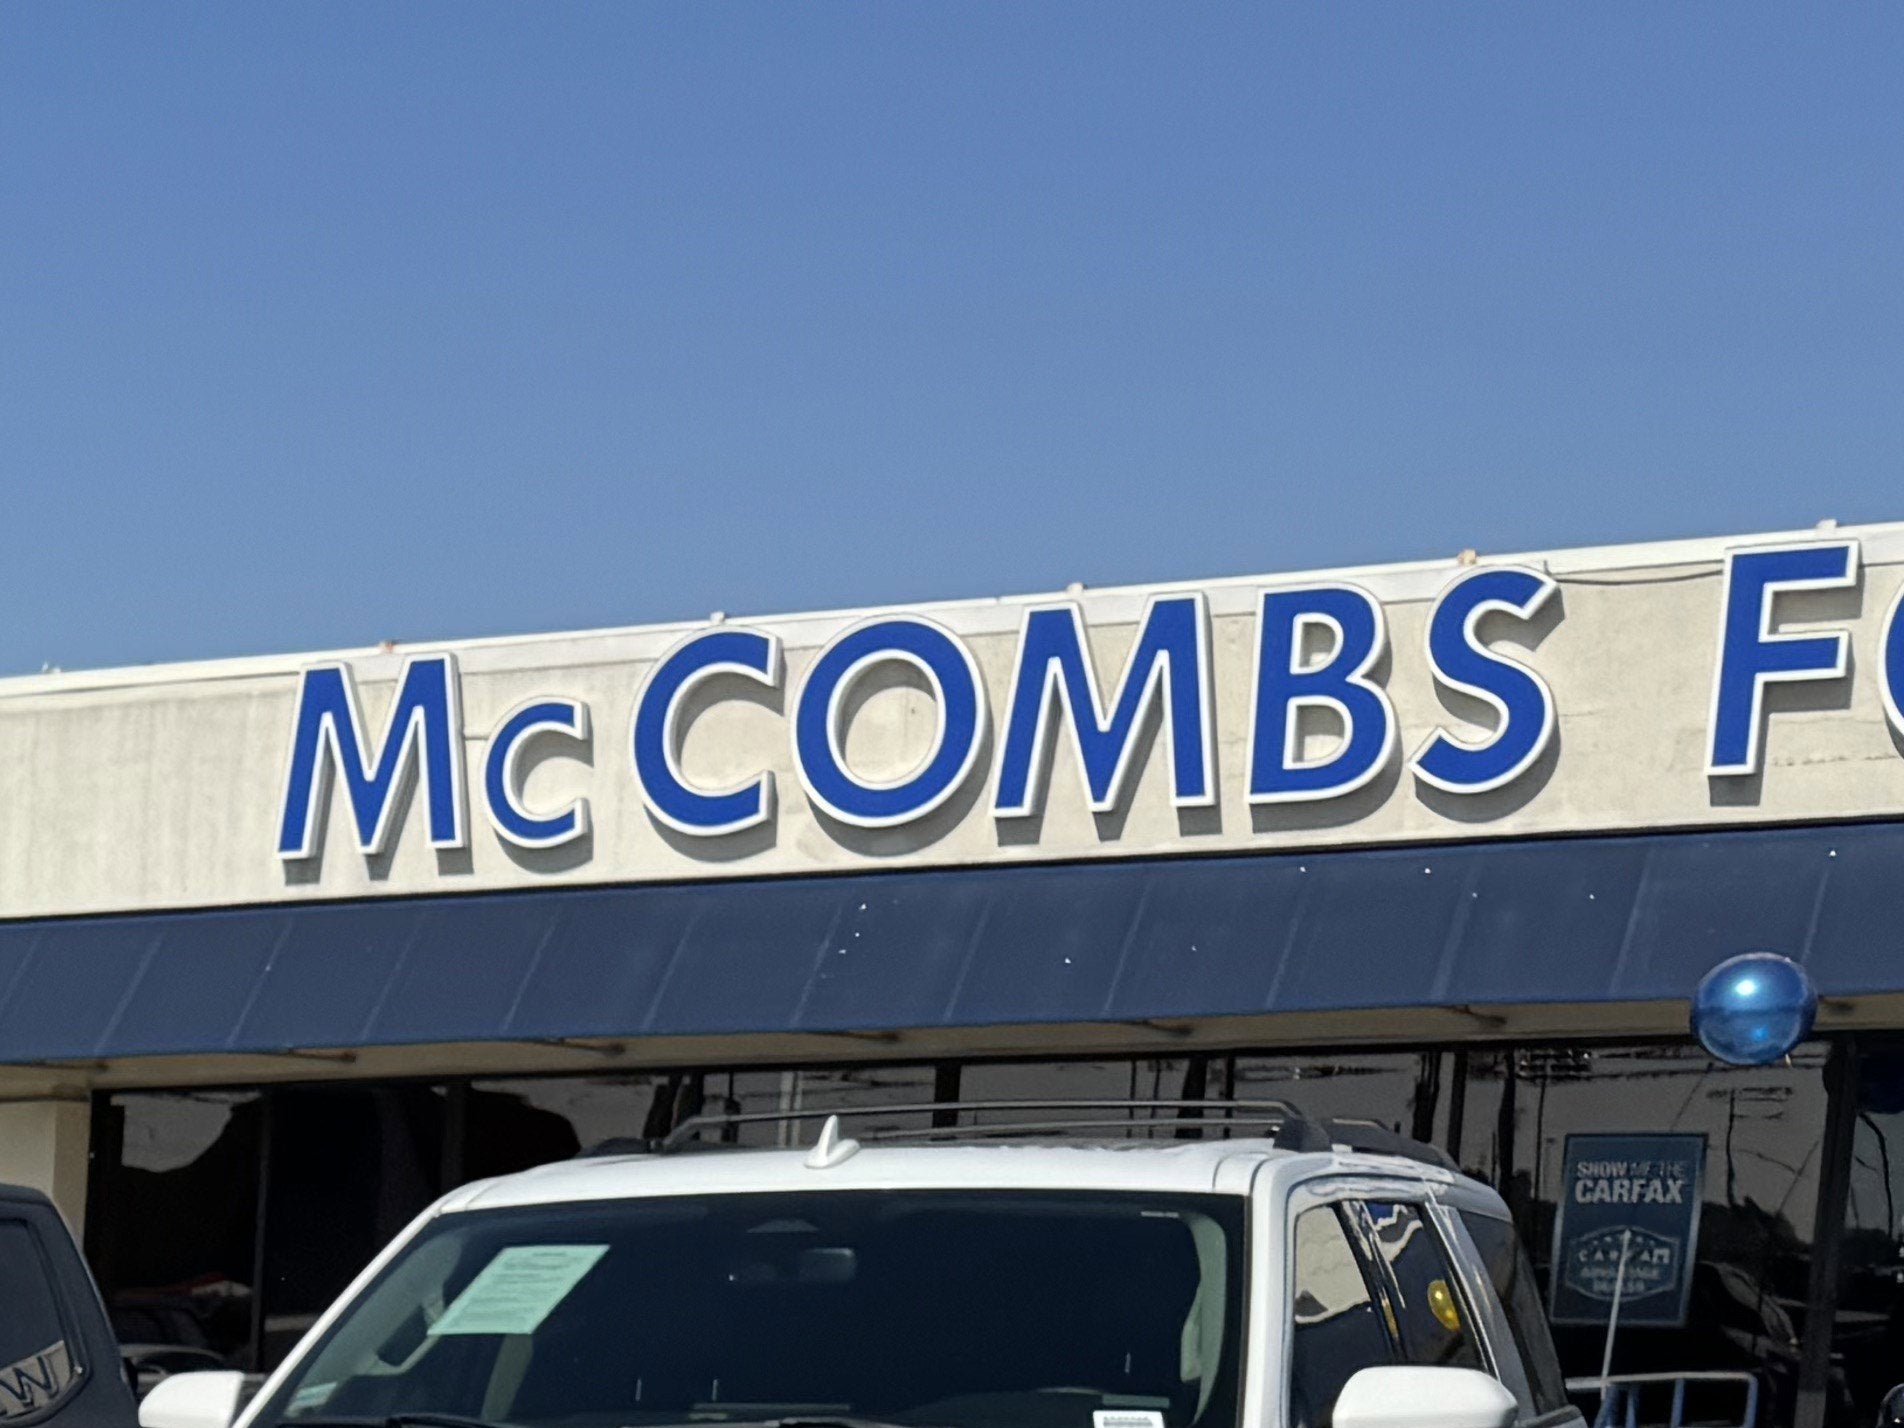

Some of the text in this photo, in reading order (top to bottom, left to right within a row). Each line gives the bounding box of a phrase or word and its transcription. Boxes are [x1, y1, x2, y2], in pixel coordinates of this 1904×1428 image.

[1705, 539, 1904, 776] F
[1577, 1161, 1628, 1178] SHOW
[1574, 1178, 1685, 1204] CARFAX
